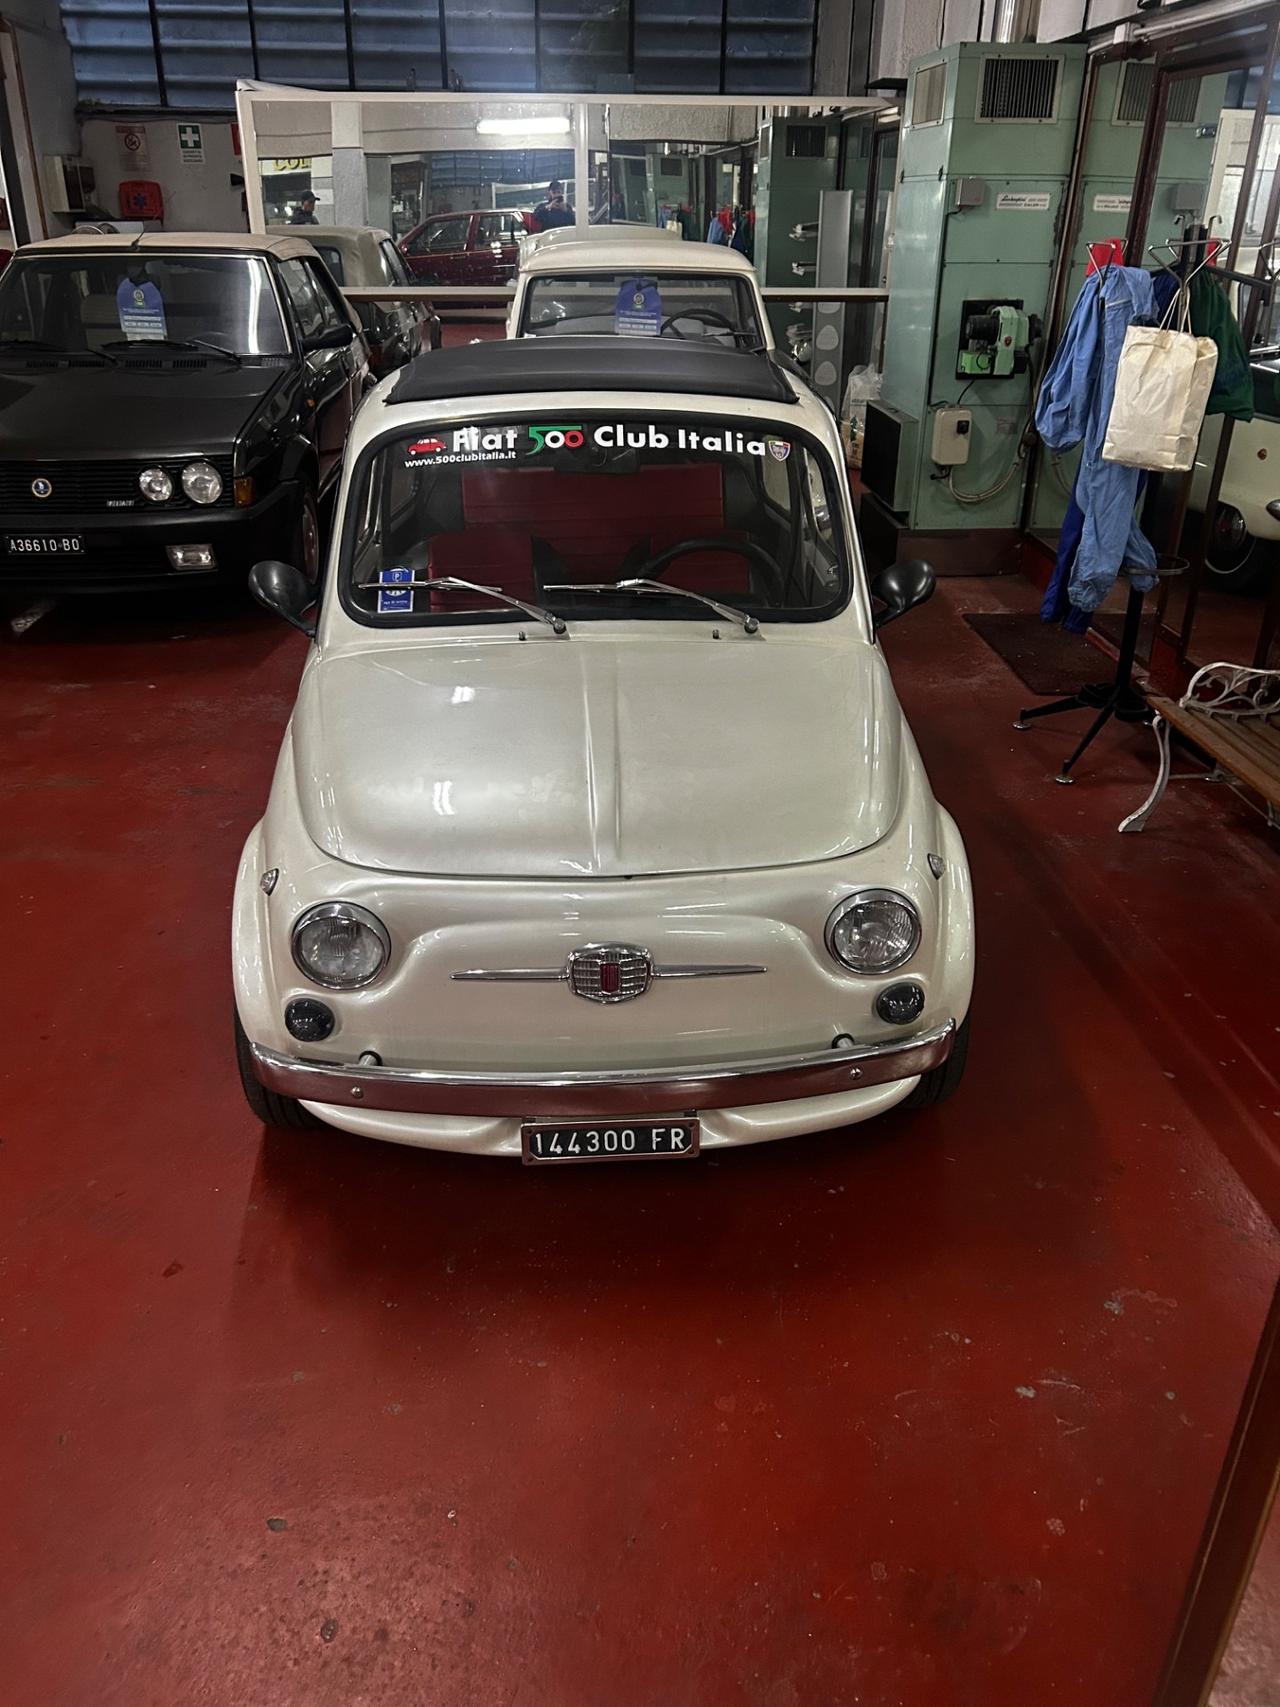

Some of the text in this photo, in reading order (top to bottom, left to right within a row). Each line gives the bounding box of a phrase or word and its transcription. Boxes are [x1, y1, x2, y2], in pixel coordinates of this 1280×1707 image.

[453, 424, 766, 456] Fiat 500 Club Italia
[10, 538, 80, 552] A36610 BO
[535, 1128, 685, 1154] 144300 FR
